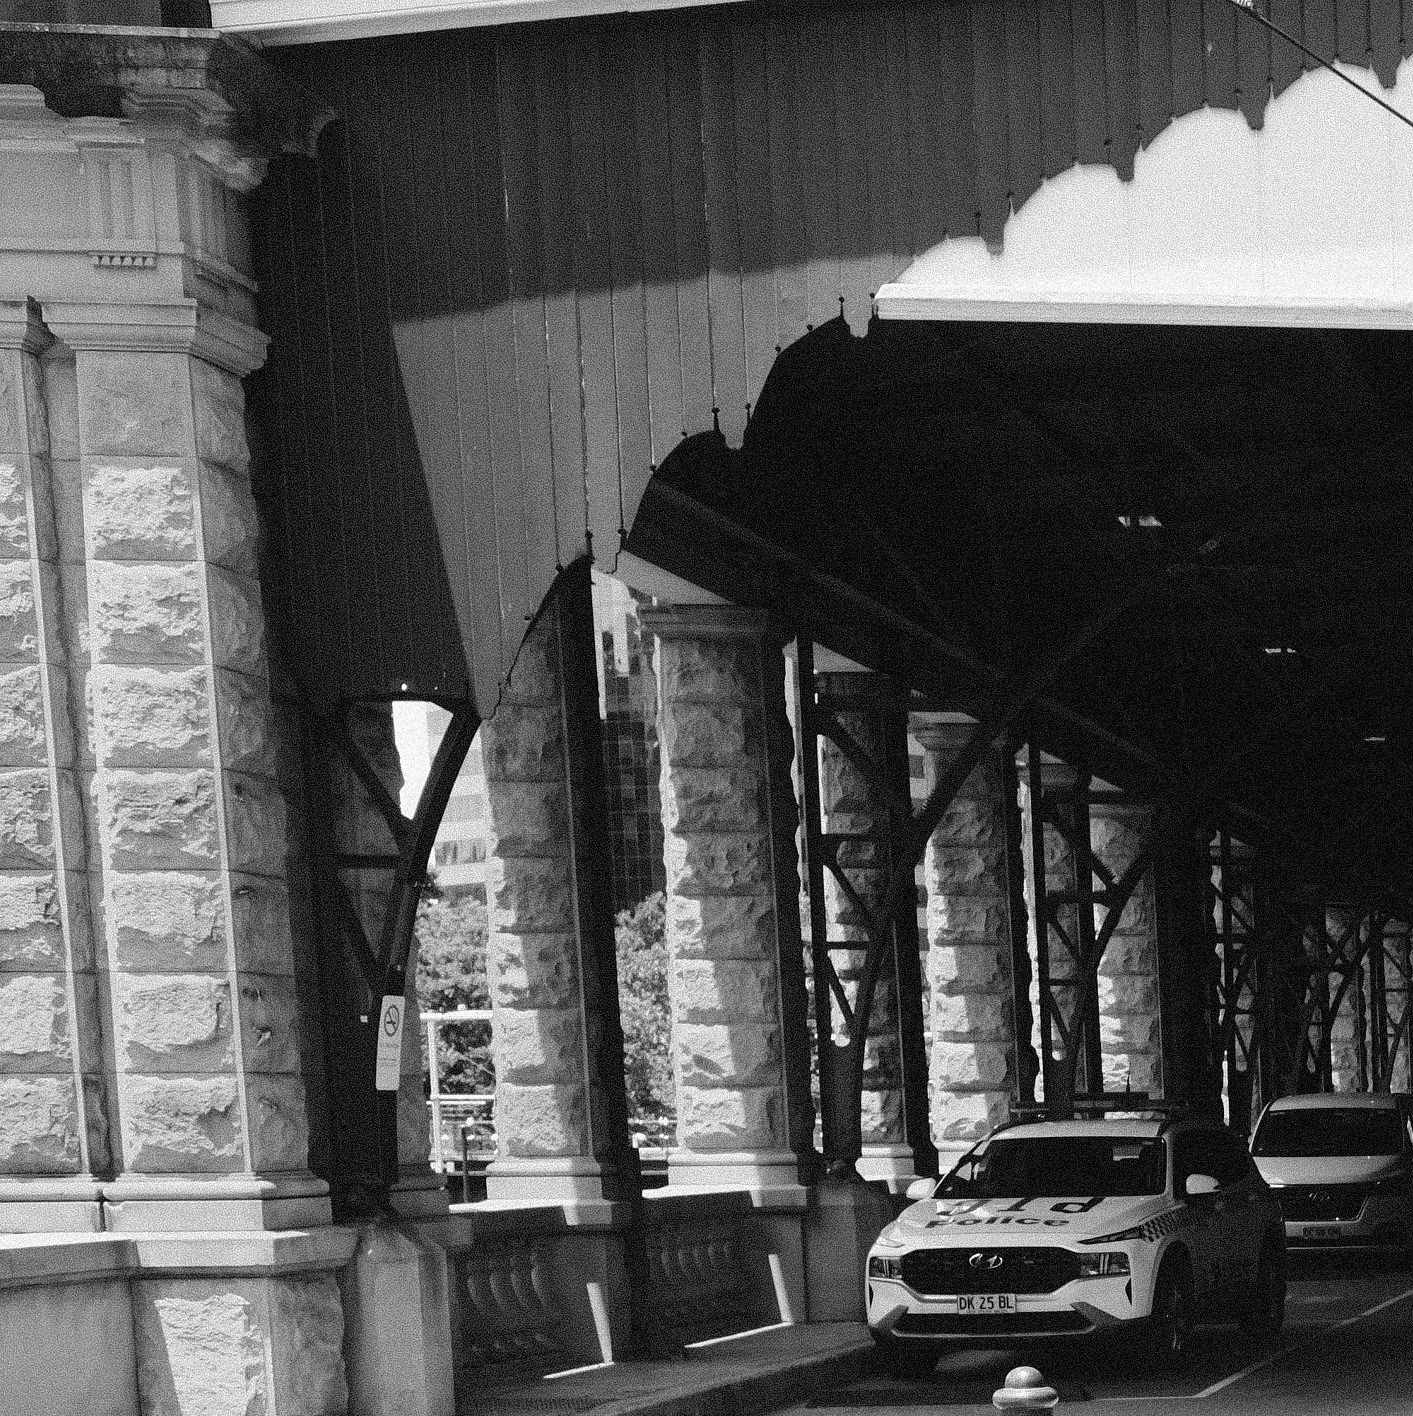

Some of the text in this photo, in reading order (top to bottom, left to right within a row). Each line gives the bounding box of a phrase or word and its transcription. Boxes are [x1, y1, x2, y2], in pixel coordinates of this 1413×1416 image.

[925, 1216, 1069, 1229] police
[959, 1295, 1014, 1310] DK 25 BL
